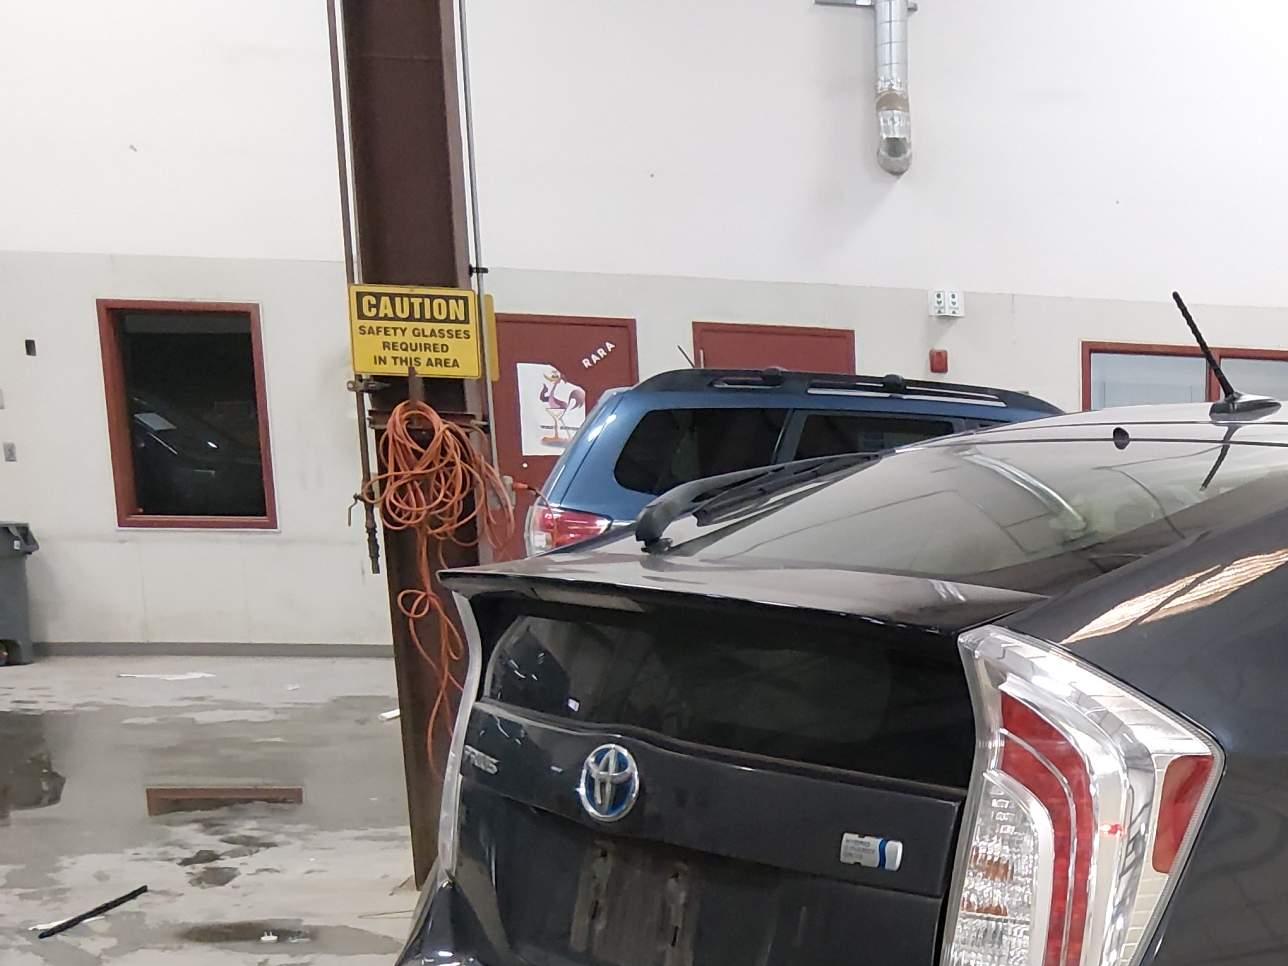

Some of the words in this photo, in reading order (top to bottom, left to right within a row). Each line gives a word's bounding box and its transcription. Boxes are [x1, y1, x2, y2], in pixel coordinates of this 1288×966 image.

[361, 294, 466, 321] CAUTION
[358, 325, 408, 336] SAFETY
[412, 327, 471, 339] GLASSES
[382, 341, 449, 352] REQUIRED
[373, 355, 387, 365] IN
[391, 356, 422, 367] THIS
[426, 358, 460, 368] AREA
[582, 341, 616, 369] RARA
